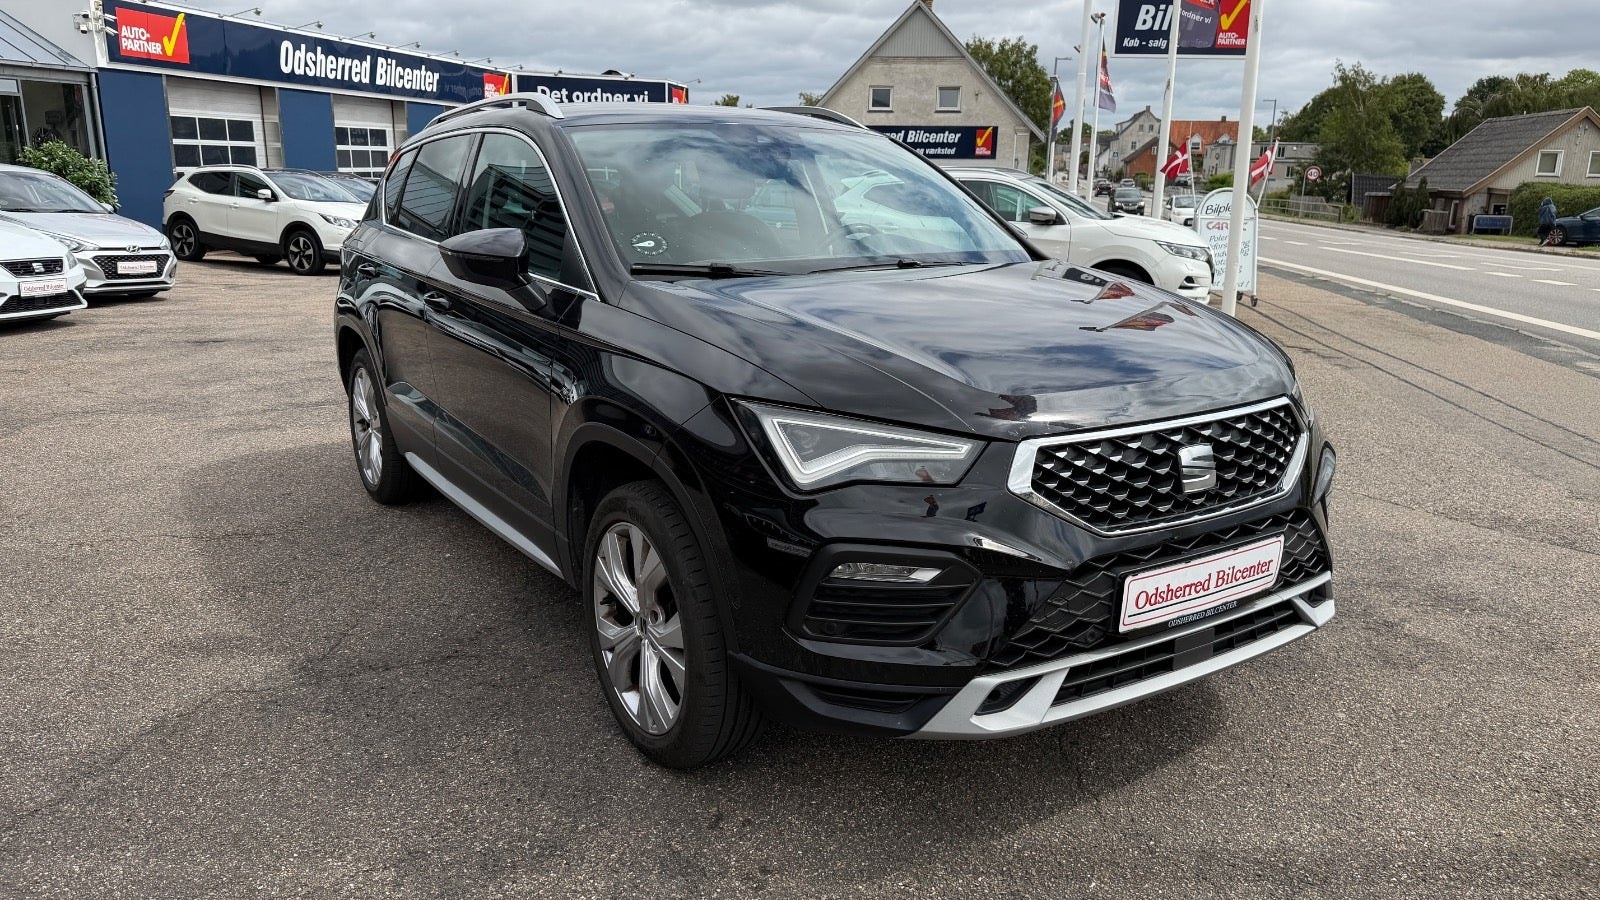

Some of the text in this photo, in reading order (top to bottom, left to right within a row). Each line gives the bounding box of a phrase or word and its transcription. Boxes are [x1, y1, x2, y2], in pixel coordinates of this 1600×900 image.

[1134, 4, 1174, 31] Bil
[1181, 9, 1212, 24] ordner vi
[121, 25, 151, 40] AUTO-
[121, 38, 163, 55] PARTNER
[1122, 37, 1139, 47] Køb
[1148, 37, 1167, 49] salg
[1217, 38, 1246, 46] PARTNER
[279, 40, 440, 92] Odsherred Bilcenter
[537, 85, 649, 103] Det ordner vi
[907, 130, 961, 144] Bilcenter
[1205, 203, 1232, 216] Bilple
[1135, 559, 1274, 610] Odsherred Bilcenter
[1168, 600, 1238, 628] ODSHERRED BILCENTER
